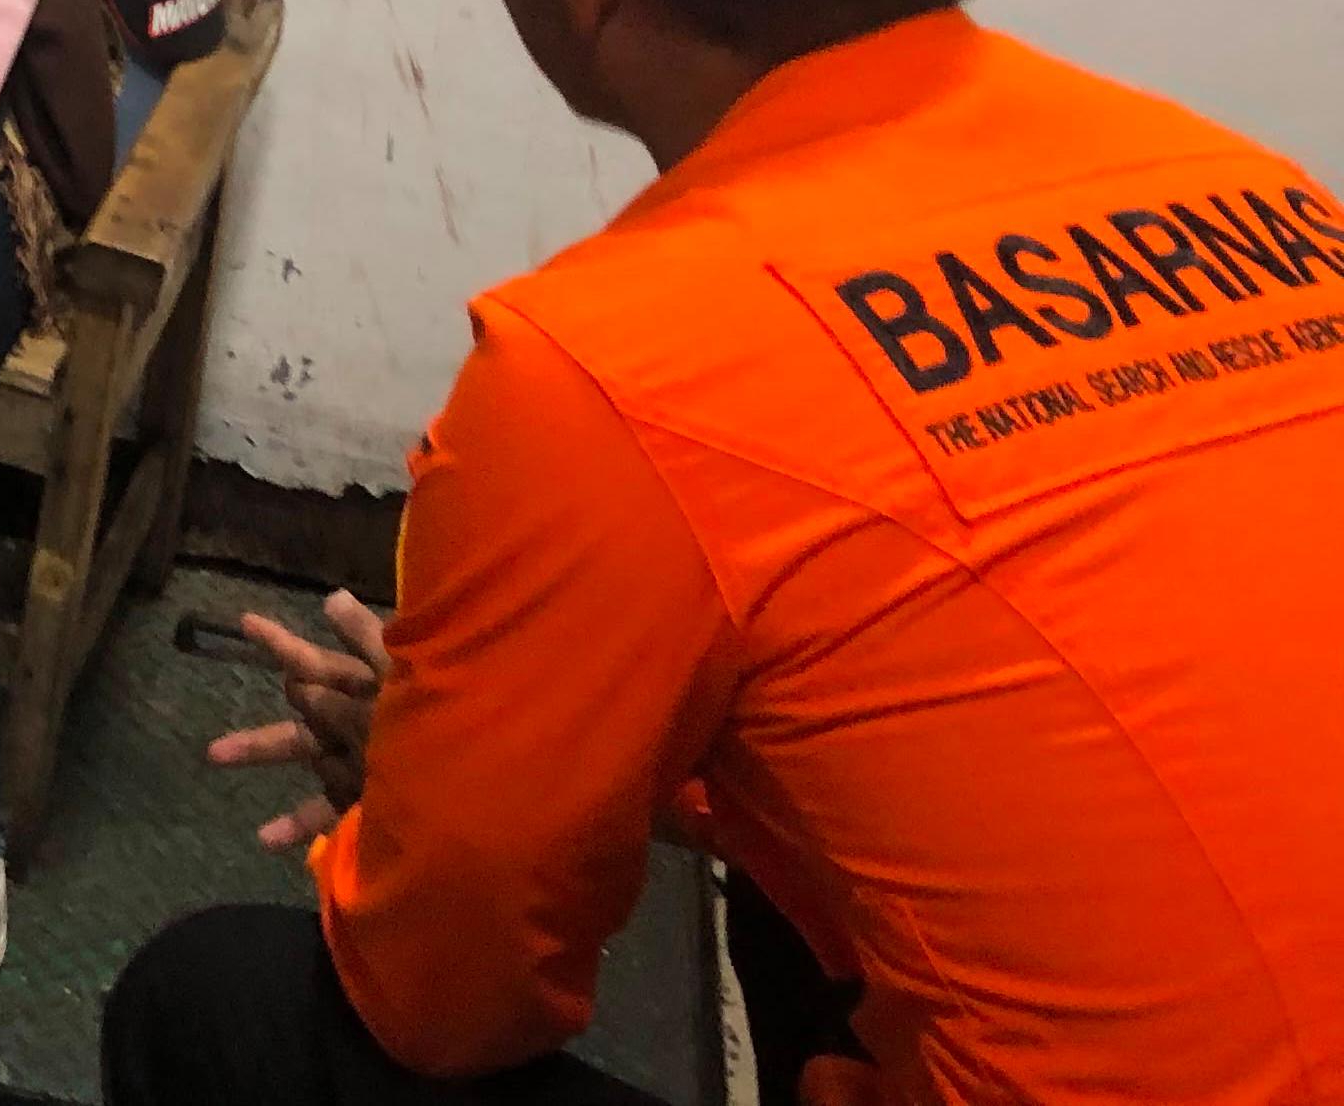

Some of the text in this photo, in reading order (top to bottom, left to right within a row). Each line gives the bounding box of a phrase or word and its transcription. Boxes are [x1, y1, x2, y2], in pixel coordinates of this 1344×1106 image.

[835, 187, 1344, 394] BASARNAS
[925, 412, 986, 456] THE
[977, 382, 1095, 441] NATIONAL
[1087, 359, 1176, 406] SEARCH
[1169, 349, 1218, 382] AND
[1209, 330, 1291, 371] RESCUE
